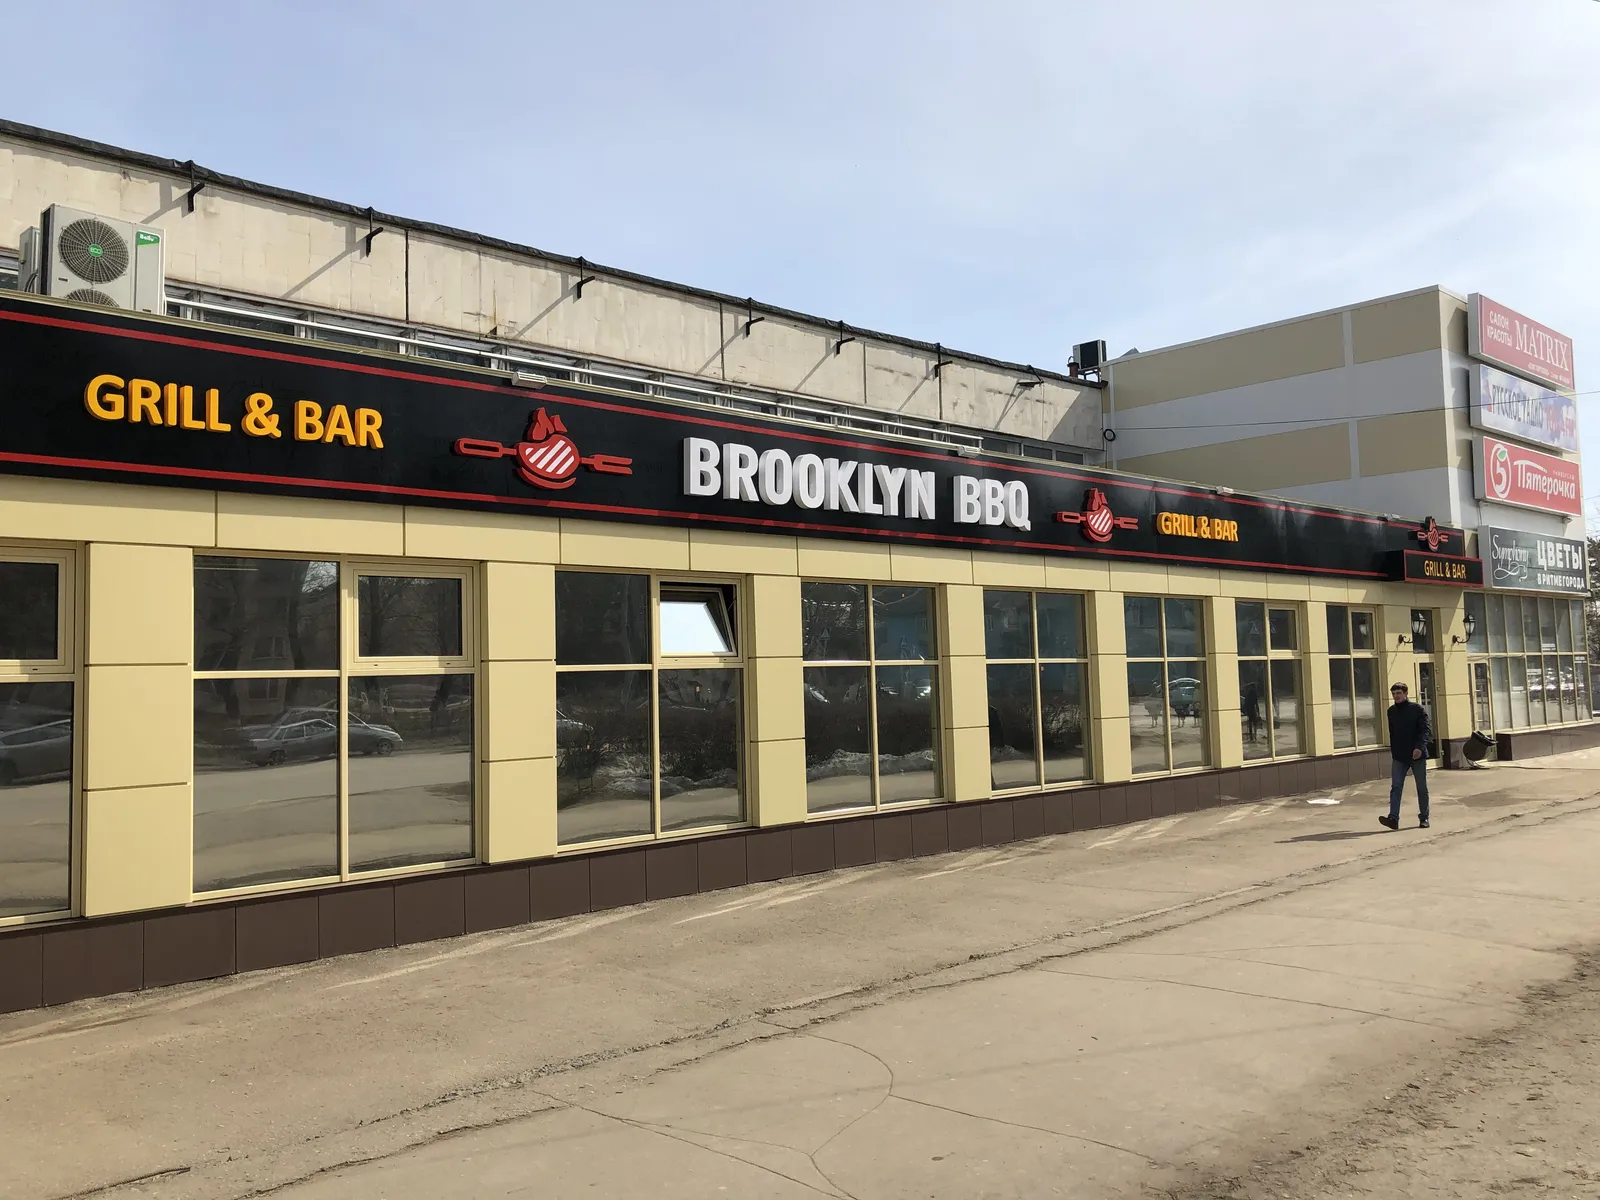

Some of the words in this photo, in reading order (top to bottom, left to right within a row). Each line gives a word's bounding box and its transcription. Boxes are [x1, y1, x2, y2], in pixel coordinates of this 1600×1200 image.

[1490, 310, 1509, 329] САЛОН
[1487, 325, 1512, 347] КРАСОТЫ
[1515, 320, 1569, 371] MATRIX
[84, 374, 231, 432] GRILL
[241, 392, 282, 438] &
[294, 399, 384, 449] BAR
[684, 437, 935, 520] BROOKLYN
[953, 475, 1031, 531] BBQ
[1513, 459, 1576, 500] Пятерочка
[1157, 511, 1197, 537] GRILL
[1197, 516, 1211, 539] &
[1212, 518, 1238, 542] BAR
[1424, 560, 1443, 576] GRILL
[1445, 562, 1451, 578] &
[1452, 563, 1466, 579] BAR
[1536, 540, 1582, 571] ЦВЕТЫ
[1537, 573, 1542, 584] В
[1542, 573, 1562, 587] РИТМЕ
[1563, 575, 1585, 590] ГОРОДА
